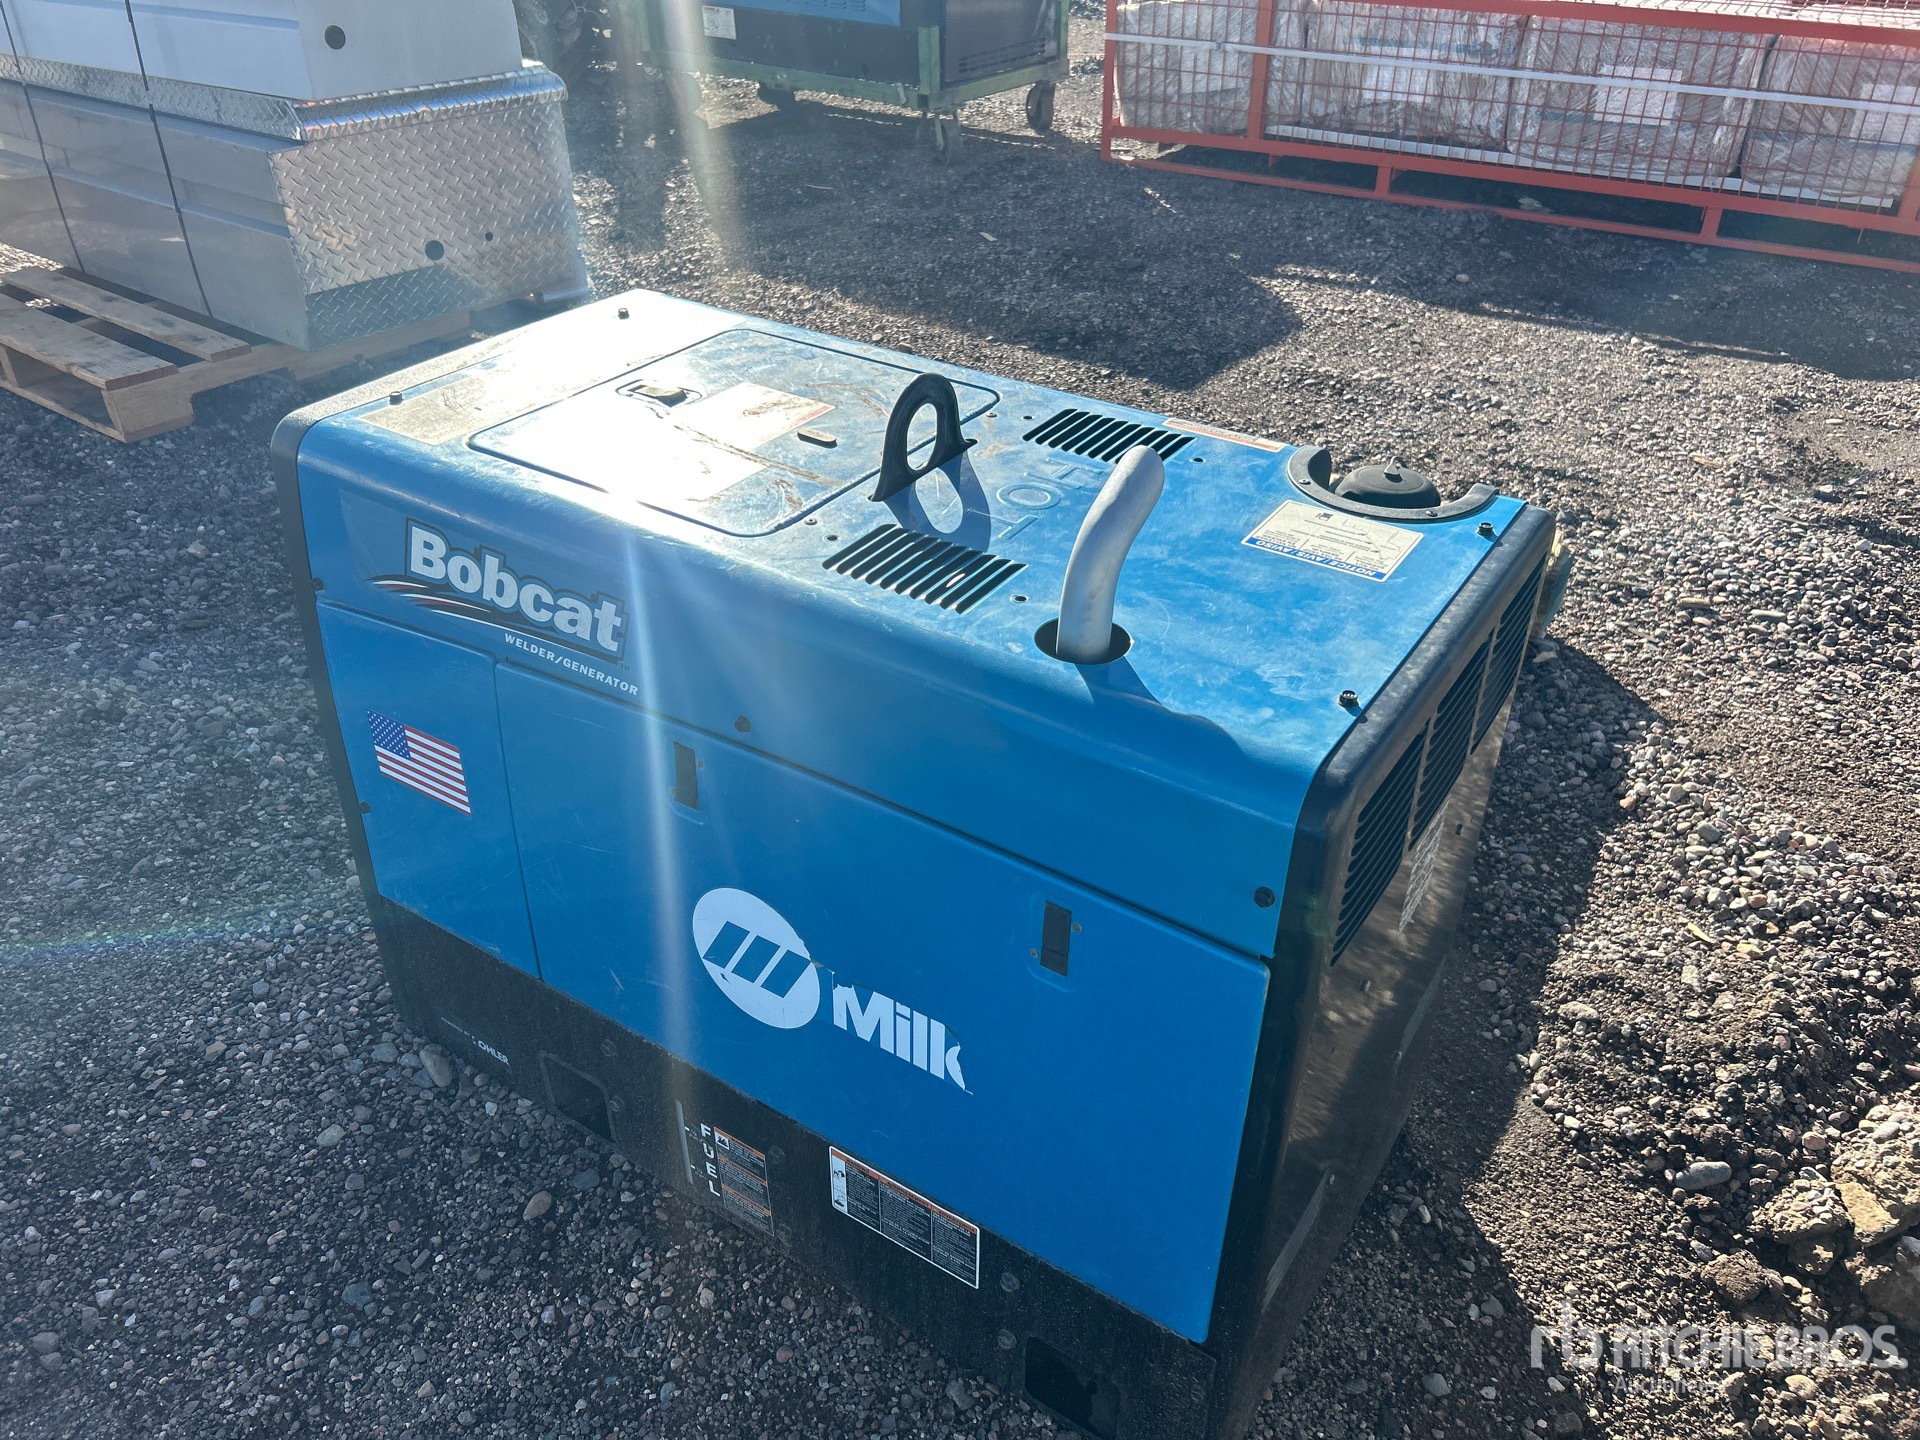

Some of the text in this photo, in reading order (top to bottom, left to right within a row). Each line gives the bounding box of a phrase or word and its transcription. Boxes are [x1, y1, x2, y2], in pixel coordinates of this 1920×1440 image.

[1253, 539, 1293, 553] AVISO
[1294, 550, 1325, 562] AVIS
[1327, 559, 1376, 576] NOTICE
[410, 526, 622, 652] Bobcat
[504, 633, 640, 696] WELDER/GENERATOR
[471, 1035, 511, 1066] OHLER
[700, 1122, 721, 1197] FUEL
